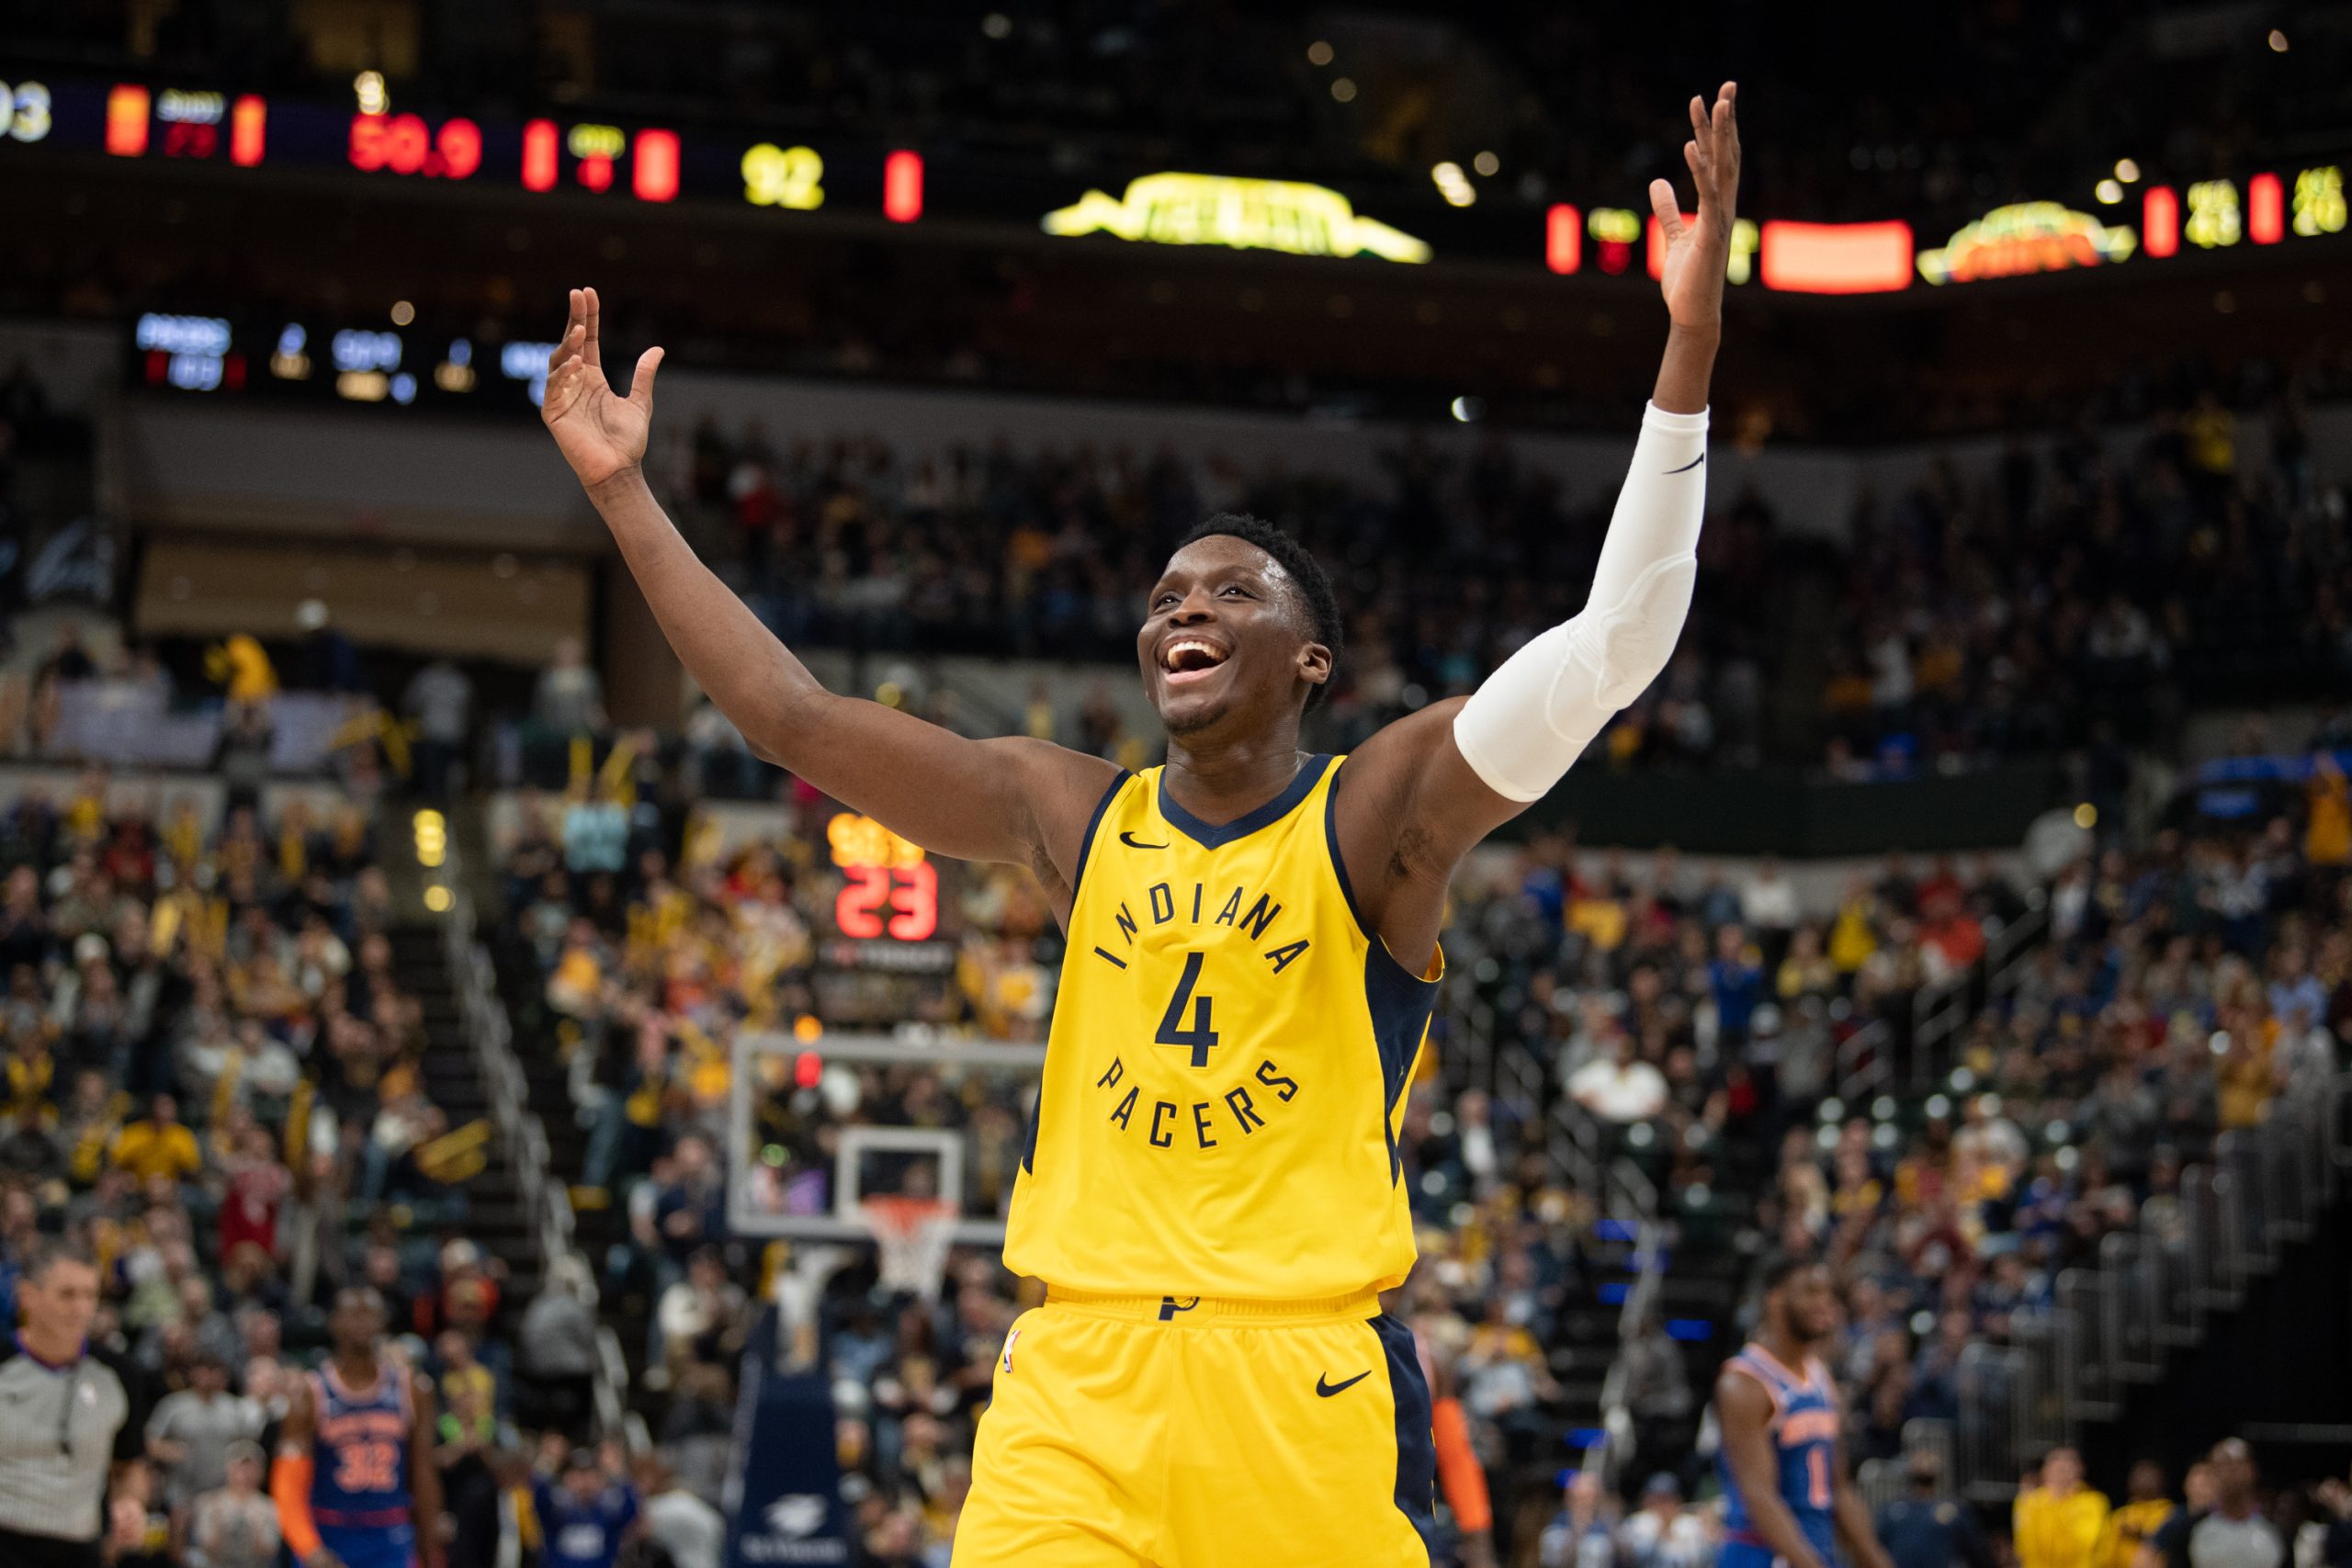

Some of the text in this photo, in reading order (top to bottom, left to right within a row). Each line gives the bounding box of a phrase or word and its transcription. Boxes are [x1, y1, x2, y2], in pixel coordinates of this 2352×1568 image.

[836, 861, 938, 941] 23
[1093, 882, 1310, 975] INDIANA
[1154, 952, 1219, 1067] 4
[1097, 1056, 1298, 1149] PACERS
